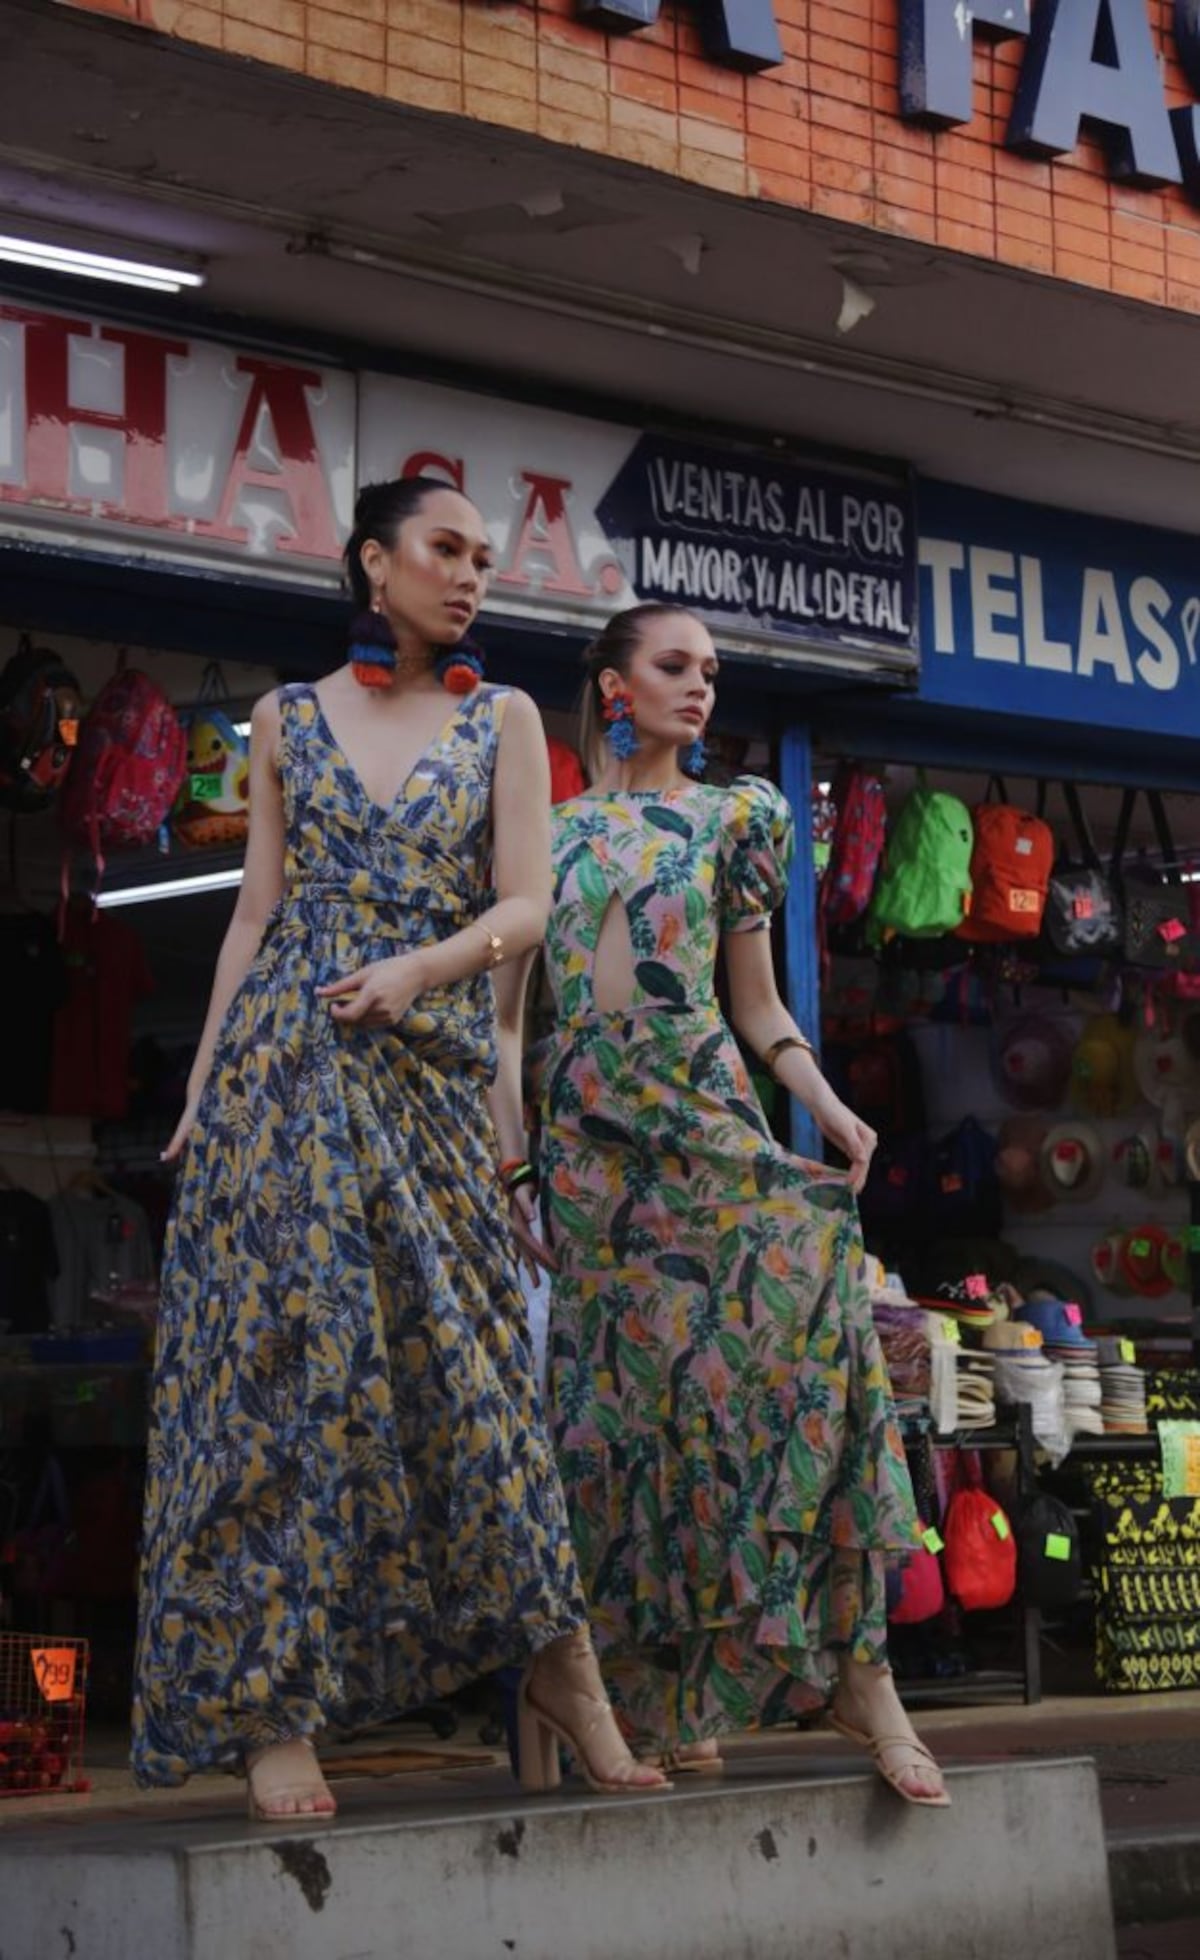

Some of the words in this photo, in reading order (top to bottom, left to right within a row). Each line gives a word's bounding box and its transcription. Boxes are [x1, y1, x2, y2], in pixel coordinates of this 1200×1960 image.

[900, 0, 1200, 204] FA
[656, 457, 785, 533] VENTAS
[795, 486, 836, 544] AL
[842, 495, 904, 557] POR
[642, 536, 743, 604] MAYOR
[825, 567, 910, 634] DETAL
[919, 537, 1180, 691] TELAS
